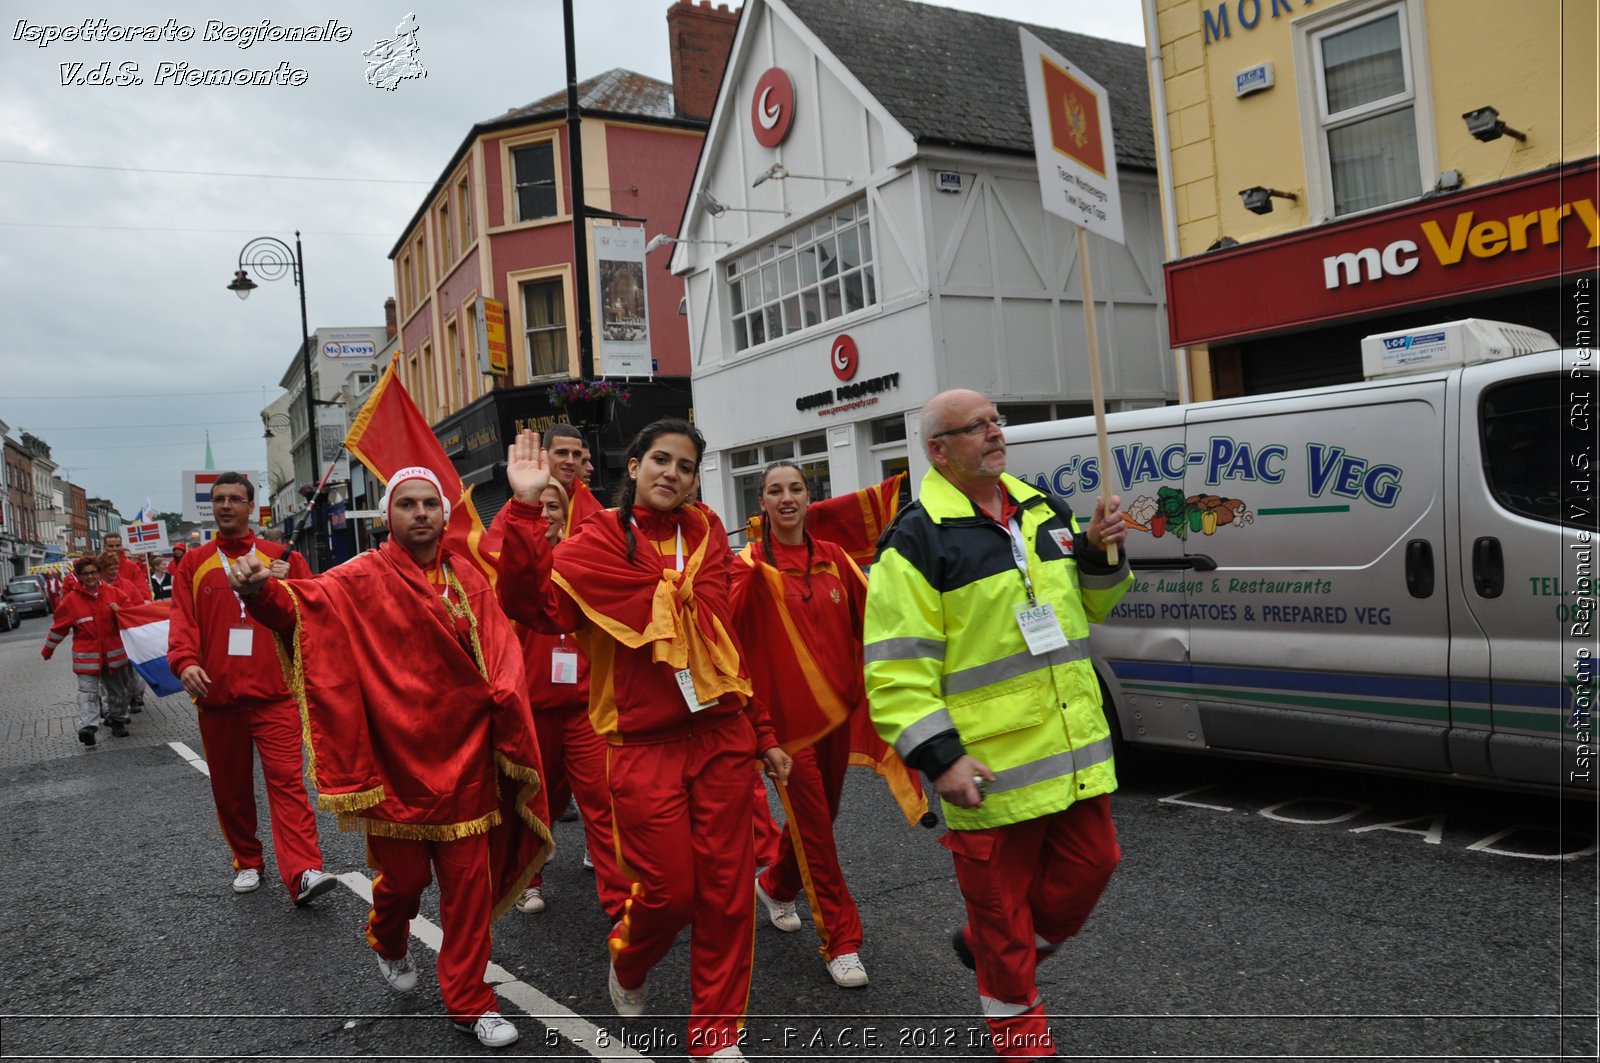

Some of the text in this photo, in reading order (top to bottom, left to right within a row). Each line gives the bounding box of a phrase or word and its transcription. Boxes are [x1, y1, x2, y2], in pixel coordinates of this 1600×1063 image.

[1056, 165, 1108, 202] Team Montenegro
[1323, 239, 1419, 290] mc
[342, 344, 373, 354] Evoys
[836, 372, 900, 401] PROPERTY
[1018, 436, 1402, 508] AC'S VAC-PAC VEG
[1211, 579, 1221, 593] &
[1228, 578, 1332, 594] Restaurants
[1107, 603, 1392, 626] ASHED POTATOES & PREPARED VEG
